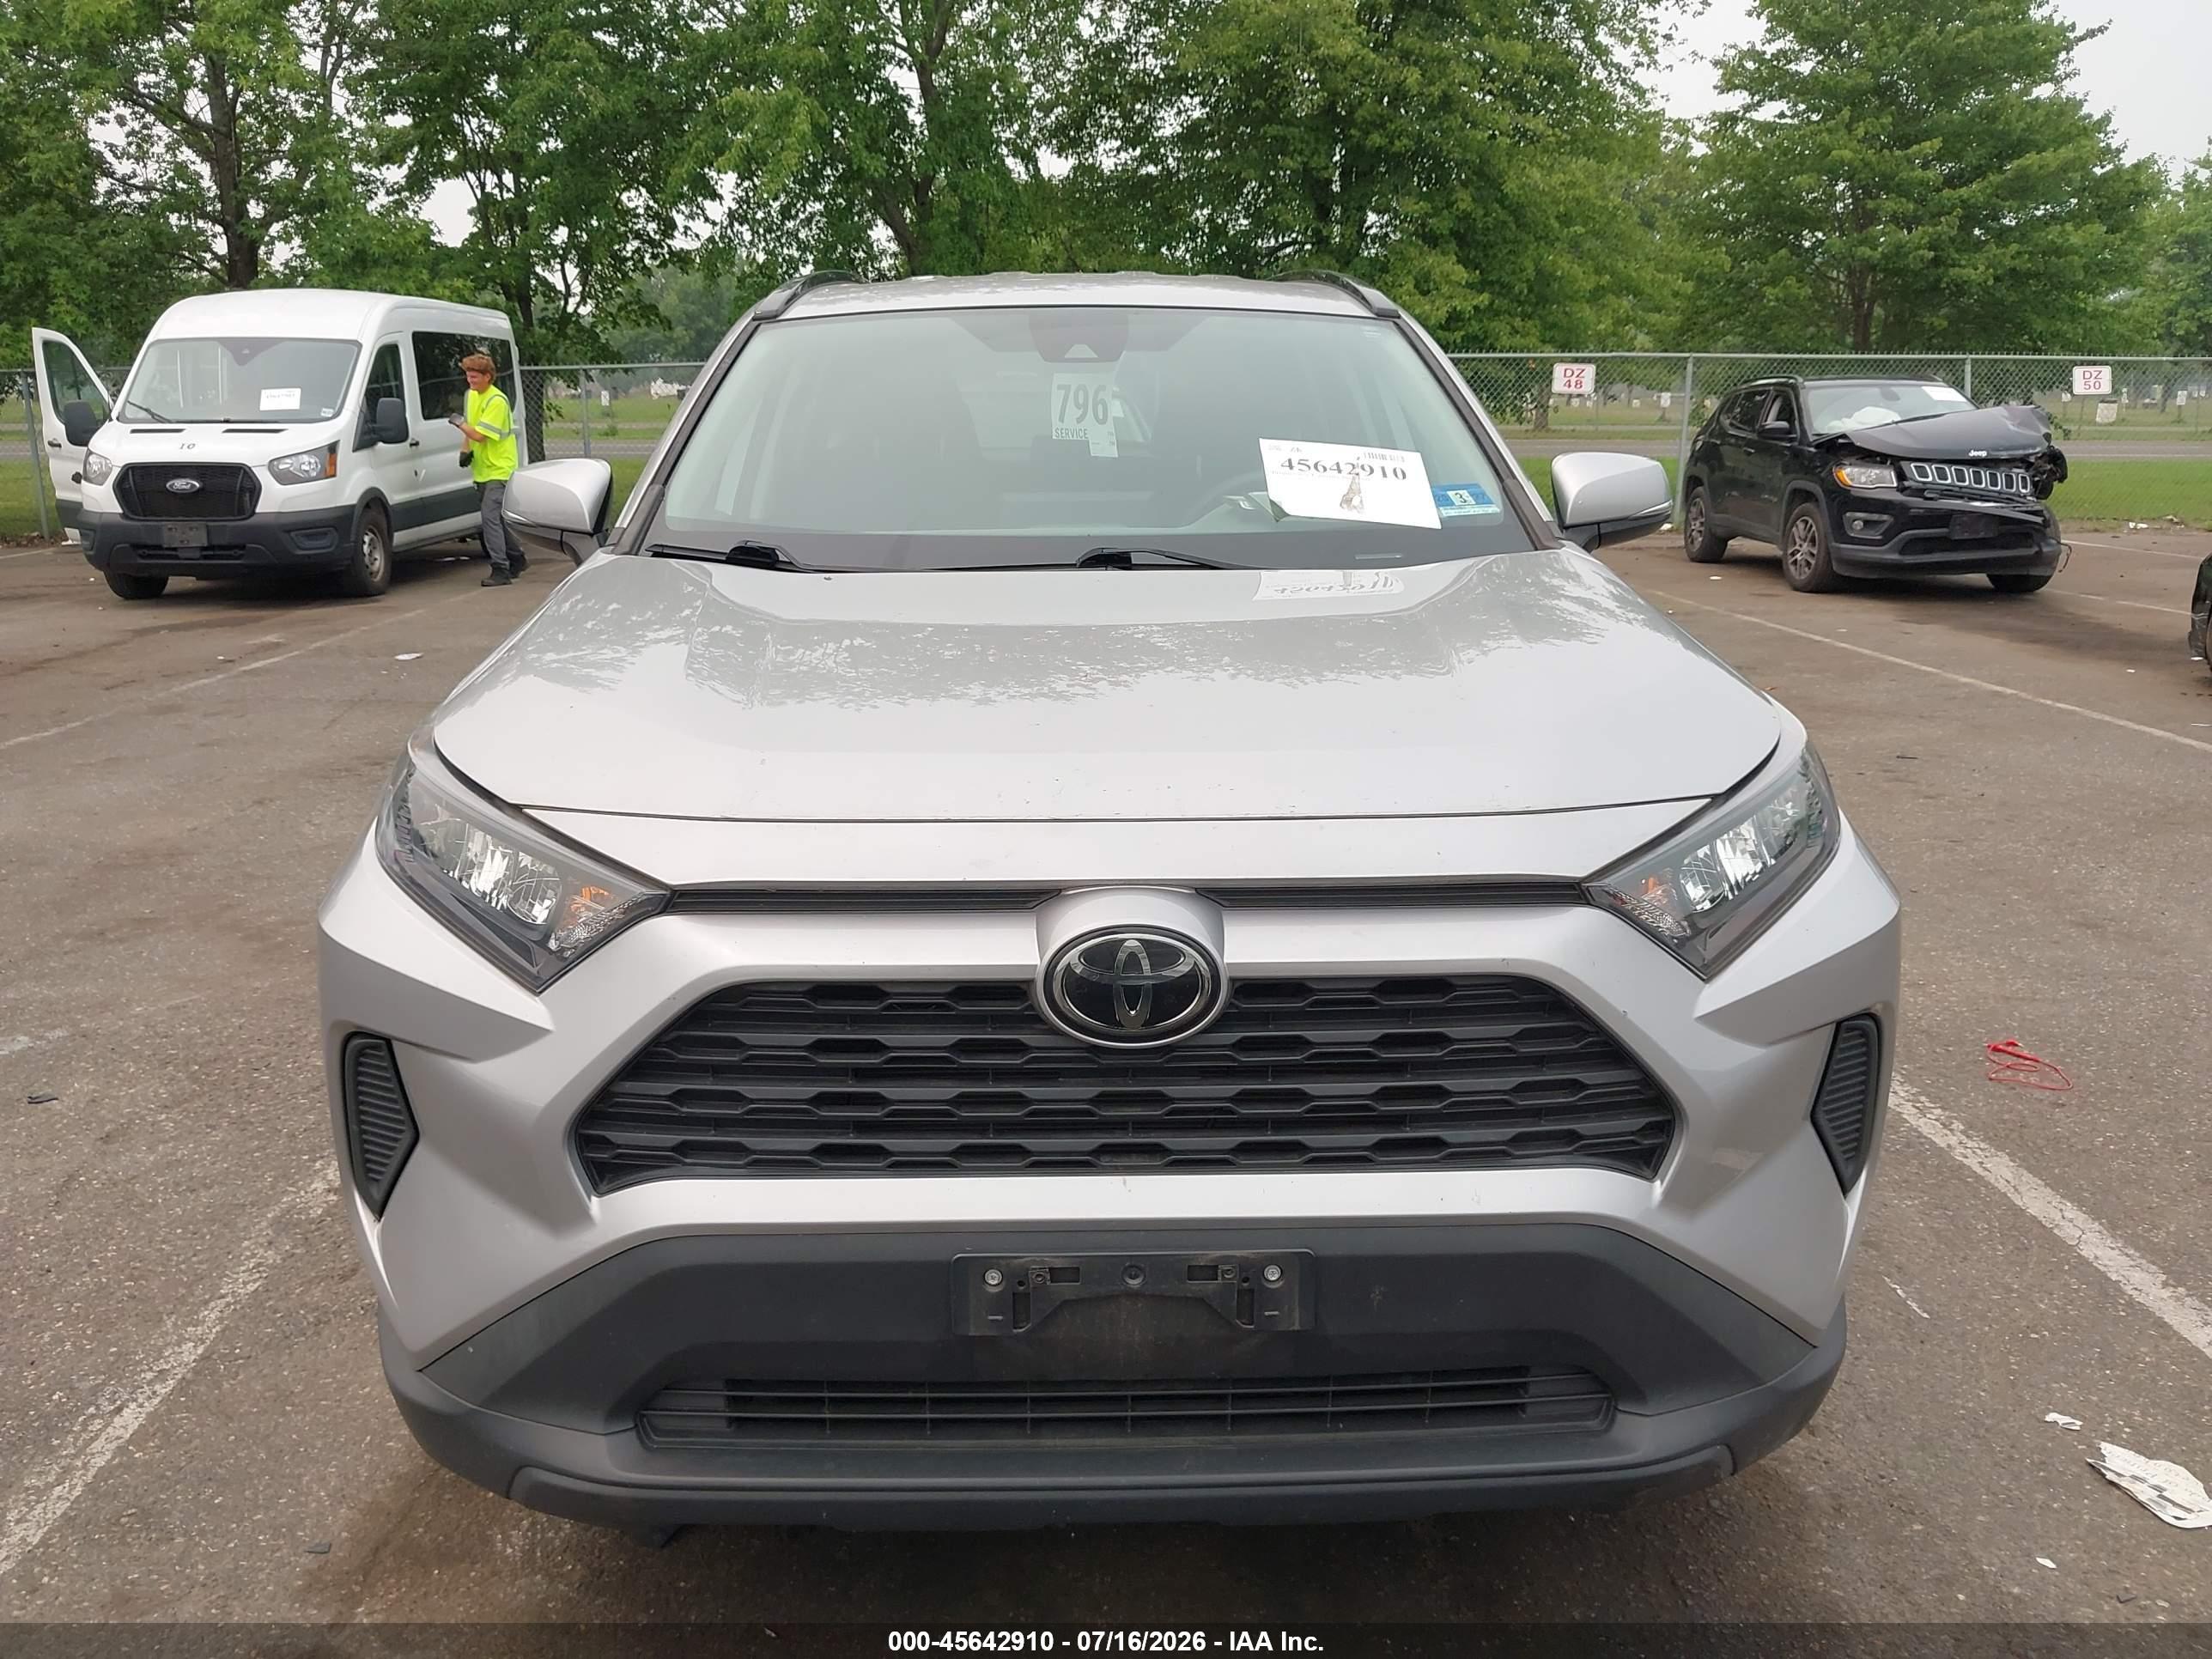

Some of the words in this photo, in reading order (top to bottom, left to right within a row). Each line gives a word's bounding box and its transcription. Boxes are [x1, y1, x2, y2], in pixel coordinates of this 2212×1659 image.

[1564, 368, 1586, 378] DZ
[2082, 370, 2103, 380] DZ
[1564, 380, 1583, 389] 48
[2083, 380, 2101, 390] 50
[1056, 384, 1109, 425] 796
[1054, 428, 1089, 439] SERVICE
[1280, 458, 1407, 480] 45642910
[1455, 492, 1467, 503] 3
